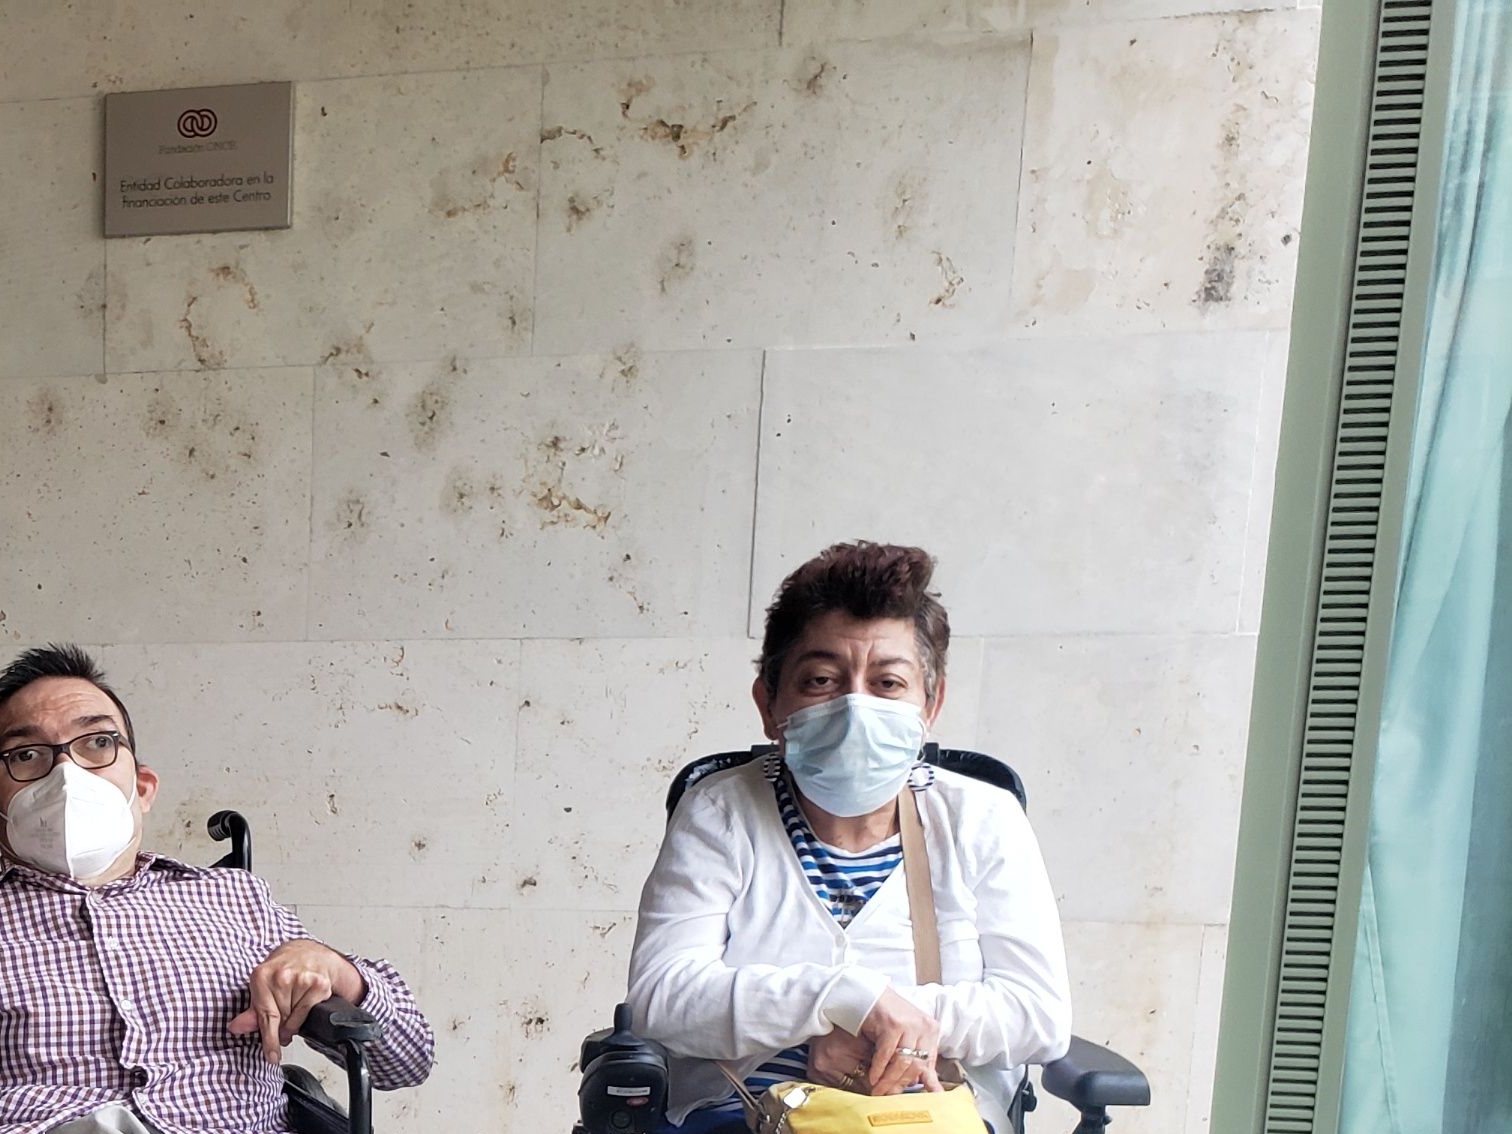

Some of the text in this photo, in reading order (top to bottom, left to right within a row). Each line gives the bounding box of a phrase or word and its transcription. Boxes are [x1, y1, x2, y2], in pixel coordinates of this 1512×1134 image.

[120, 171, 275, 192] Entidad Colaboradora en la
[122, 189, 272, 209] financiación de este Centro
